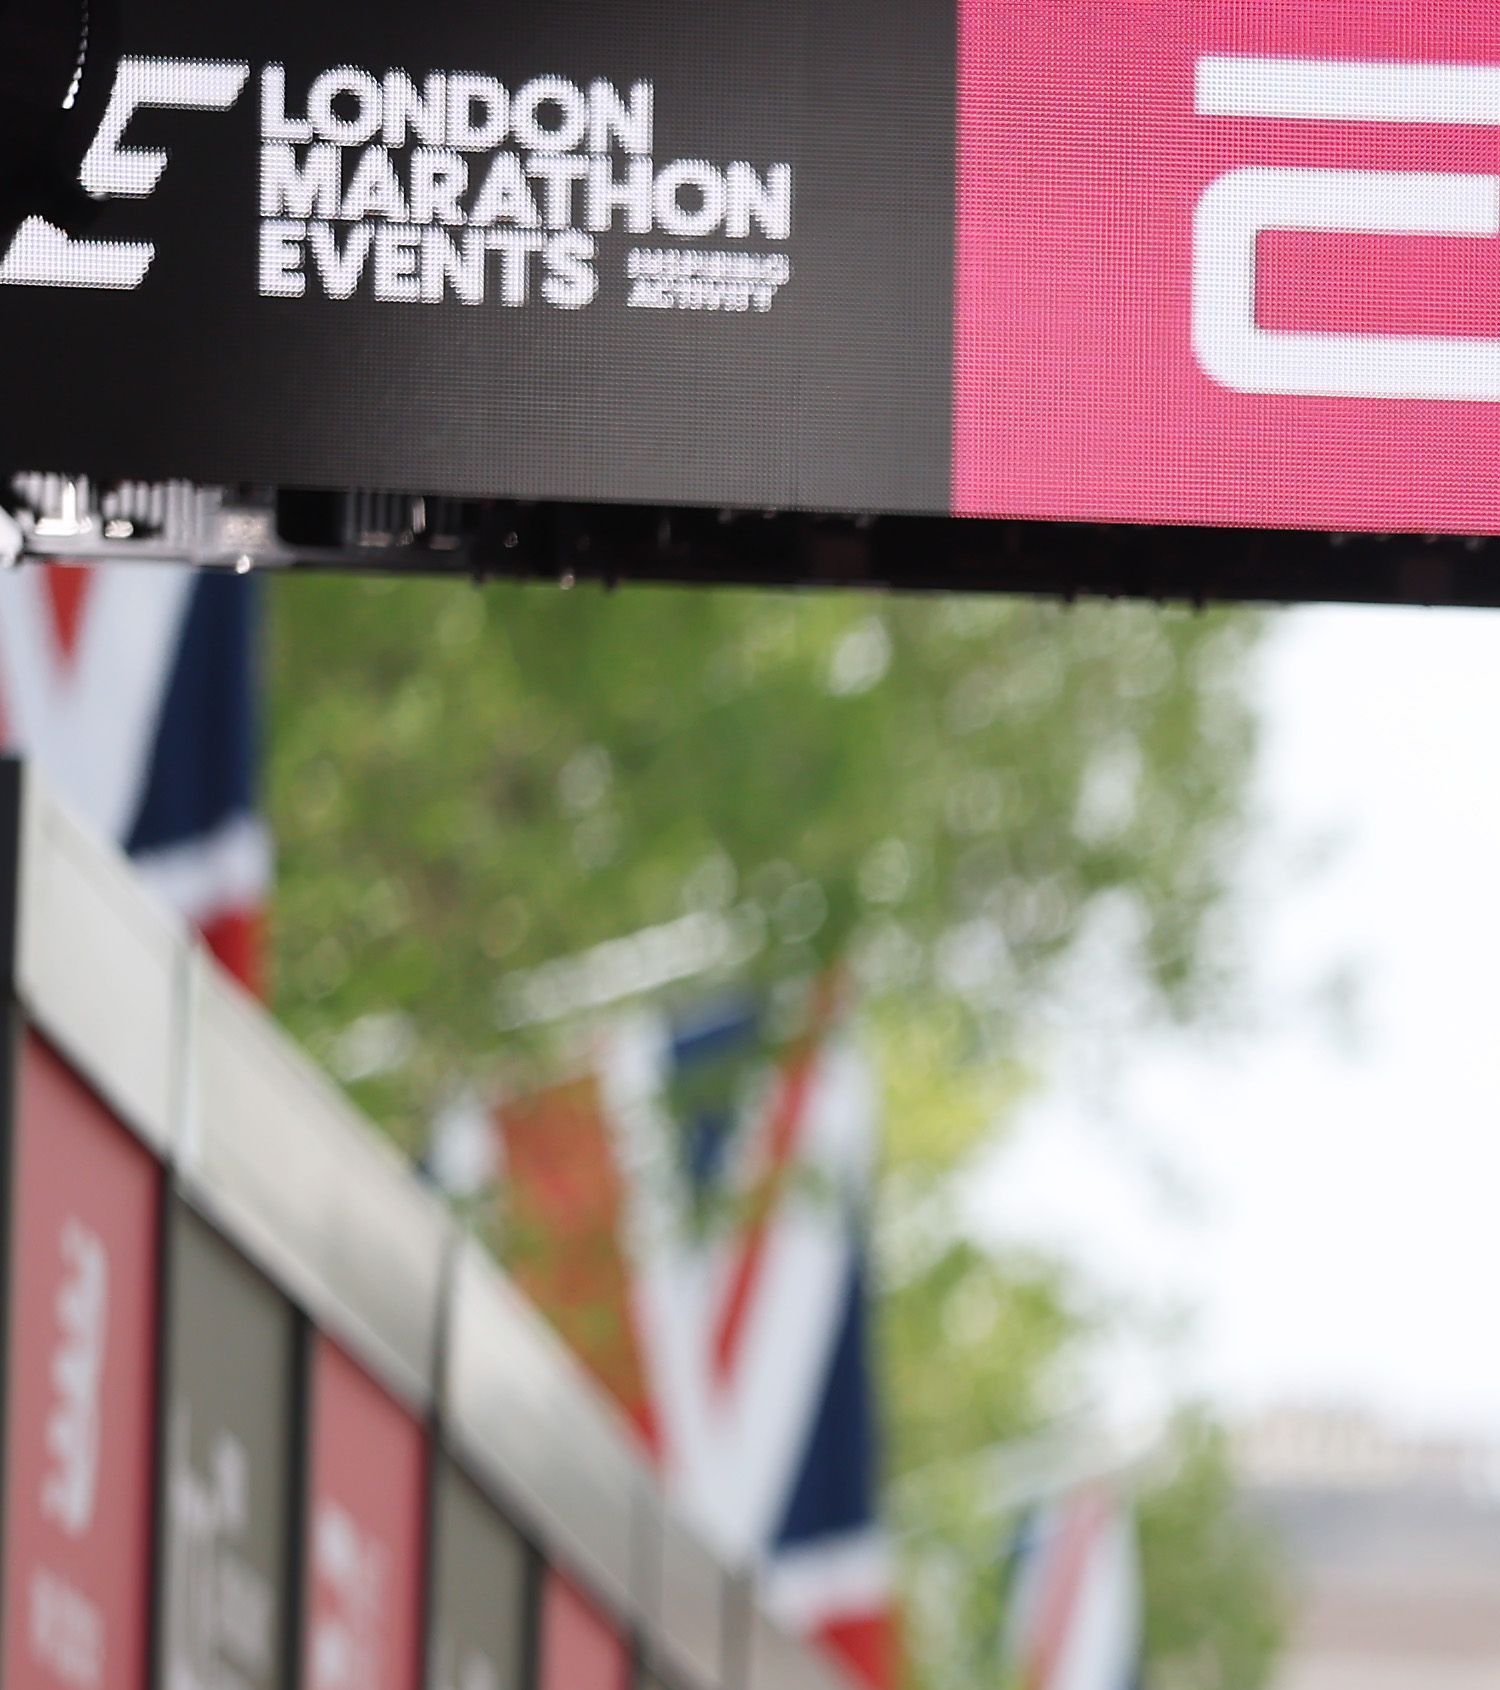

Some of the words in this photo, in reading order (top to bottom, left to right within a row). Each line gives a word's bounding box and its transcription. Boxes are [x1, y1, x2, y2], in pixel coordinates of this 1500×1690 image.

[259, 62, 655, 154] LONDON
[258, 142, 793, 240] MARATHON
[258, 217, 601, 310] EVENTS
